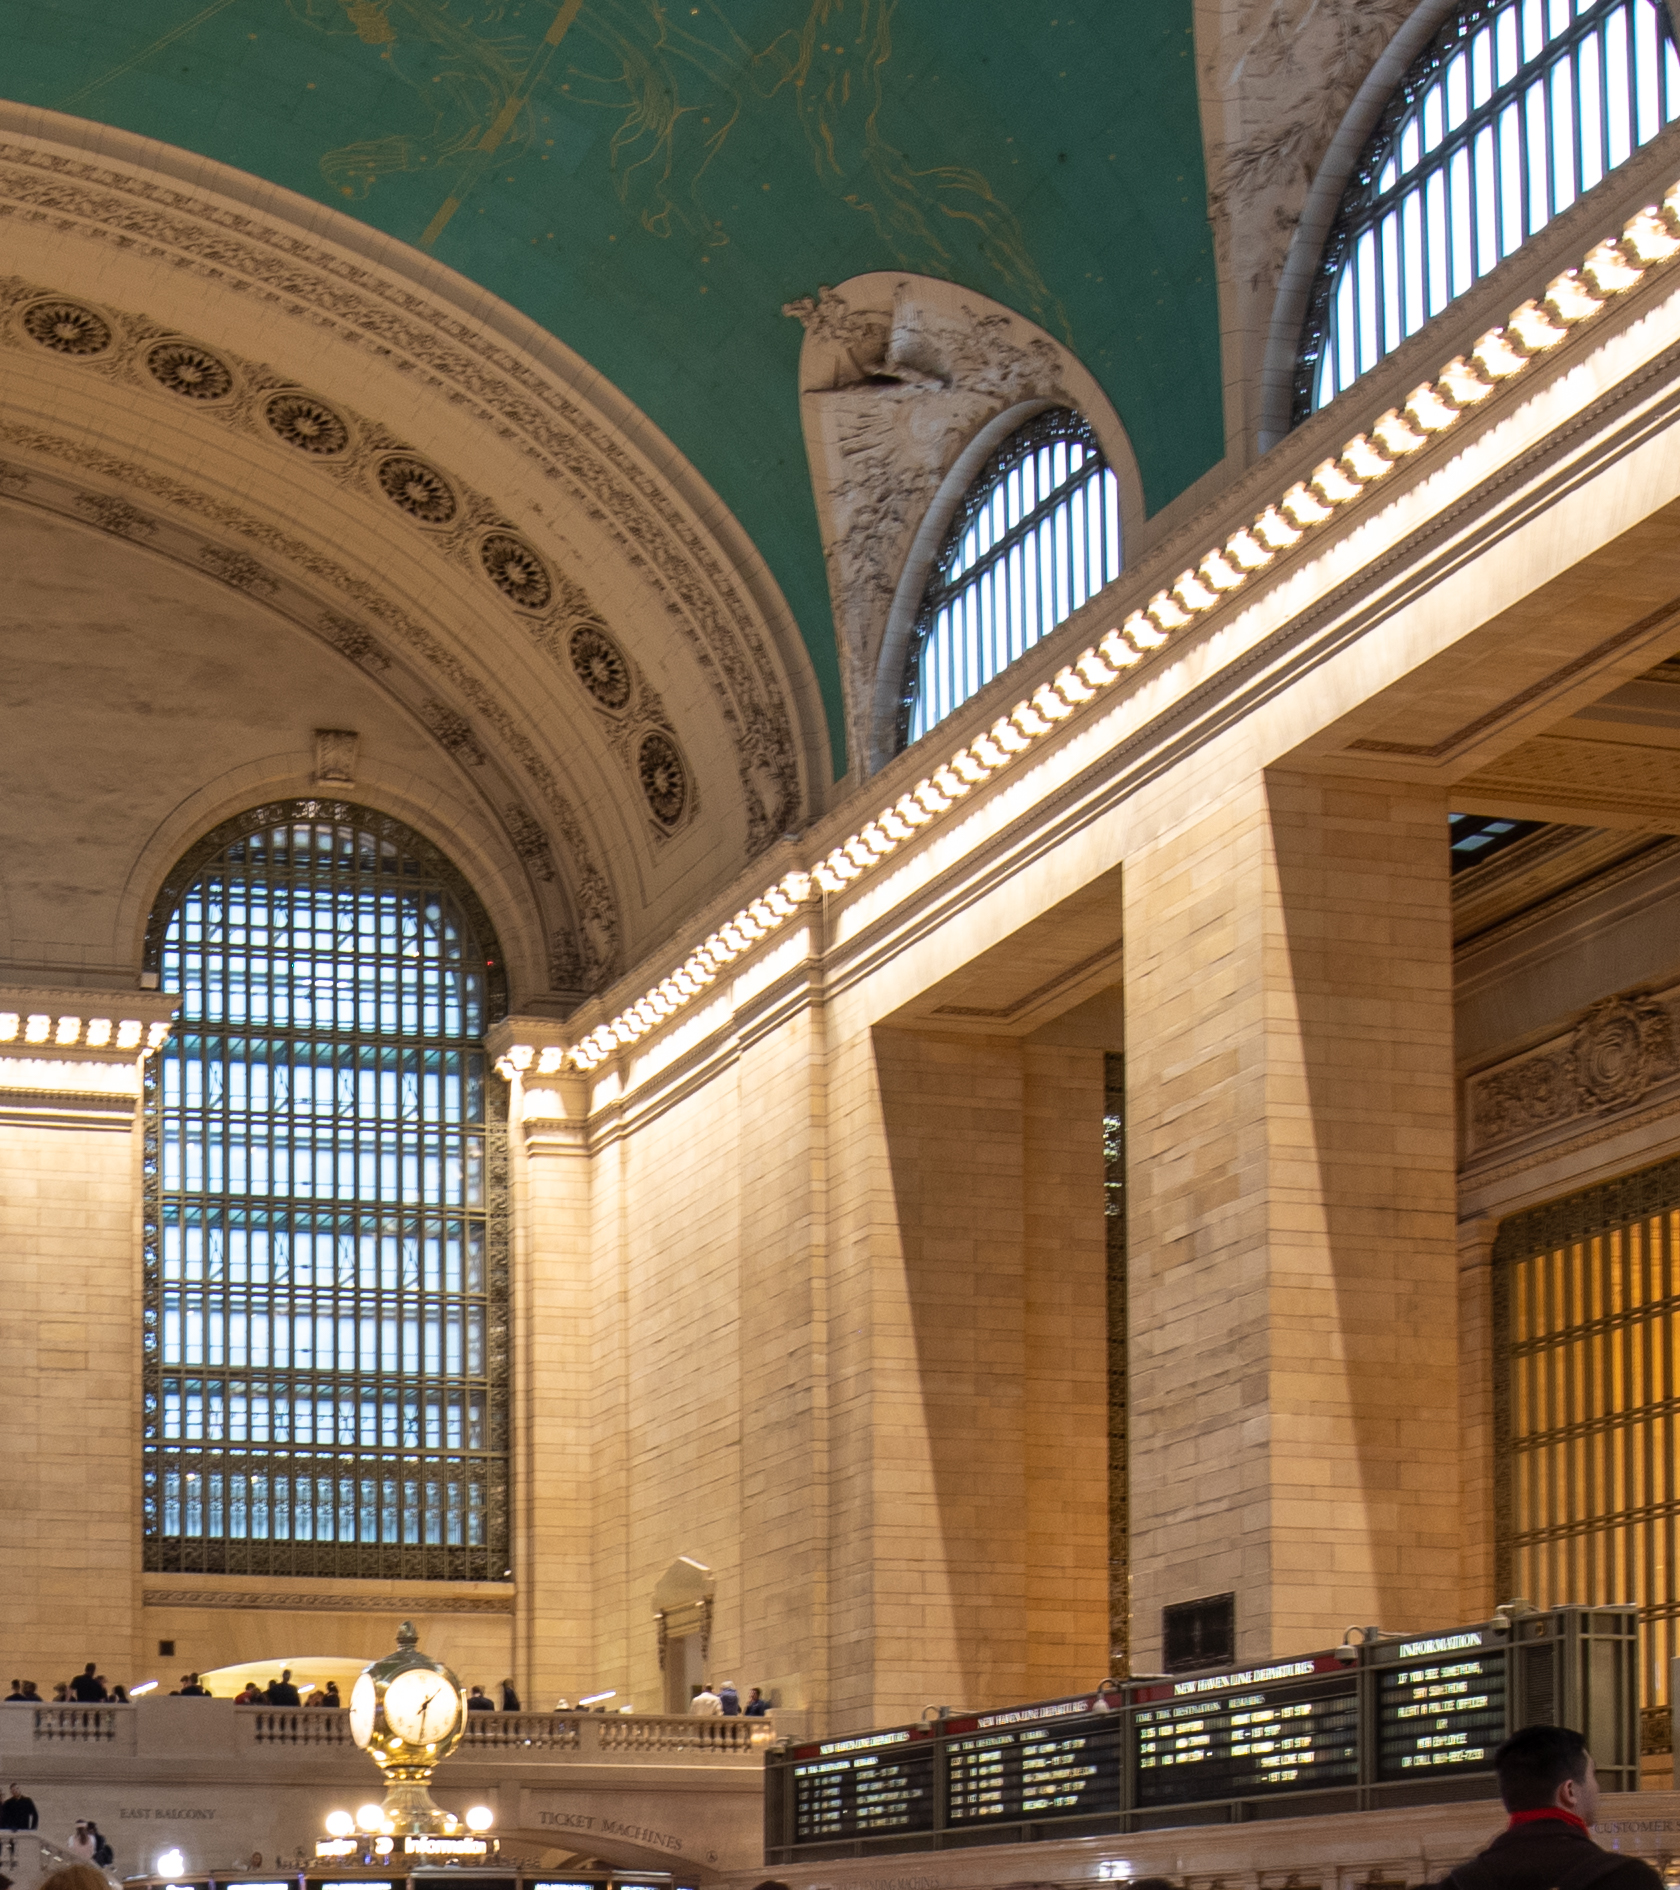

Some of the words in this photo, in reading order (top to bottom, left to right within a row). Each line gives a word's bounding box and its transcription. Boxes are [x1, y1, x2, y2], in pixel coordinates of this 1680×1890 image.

[1399, 1632, 1482, 1658] INFORMATION
[120, 1808, 151, 1819] EAST
[155, 1808, 217, 1820] BALCONY
[539, 1811, 596, 1829] TICKET
[601, 1819, 683, 1850] MACHINES
[1594, 1821, 1673, 1834] CUSTOMER
